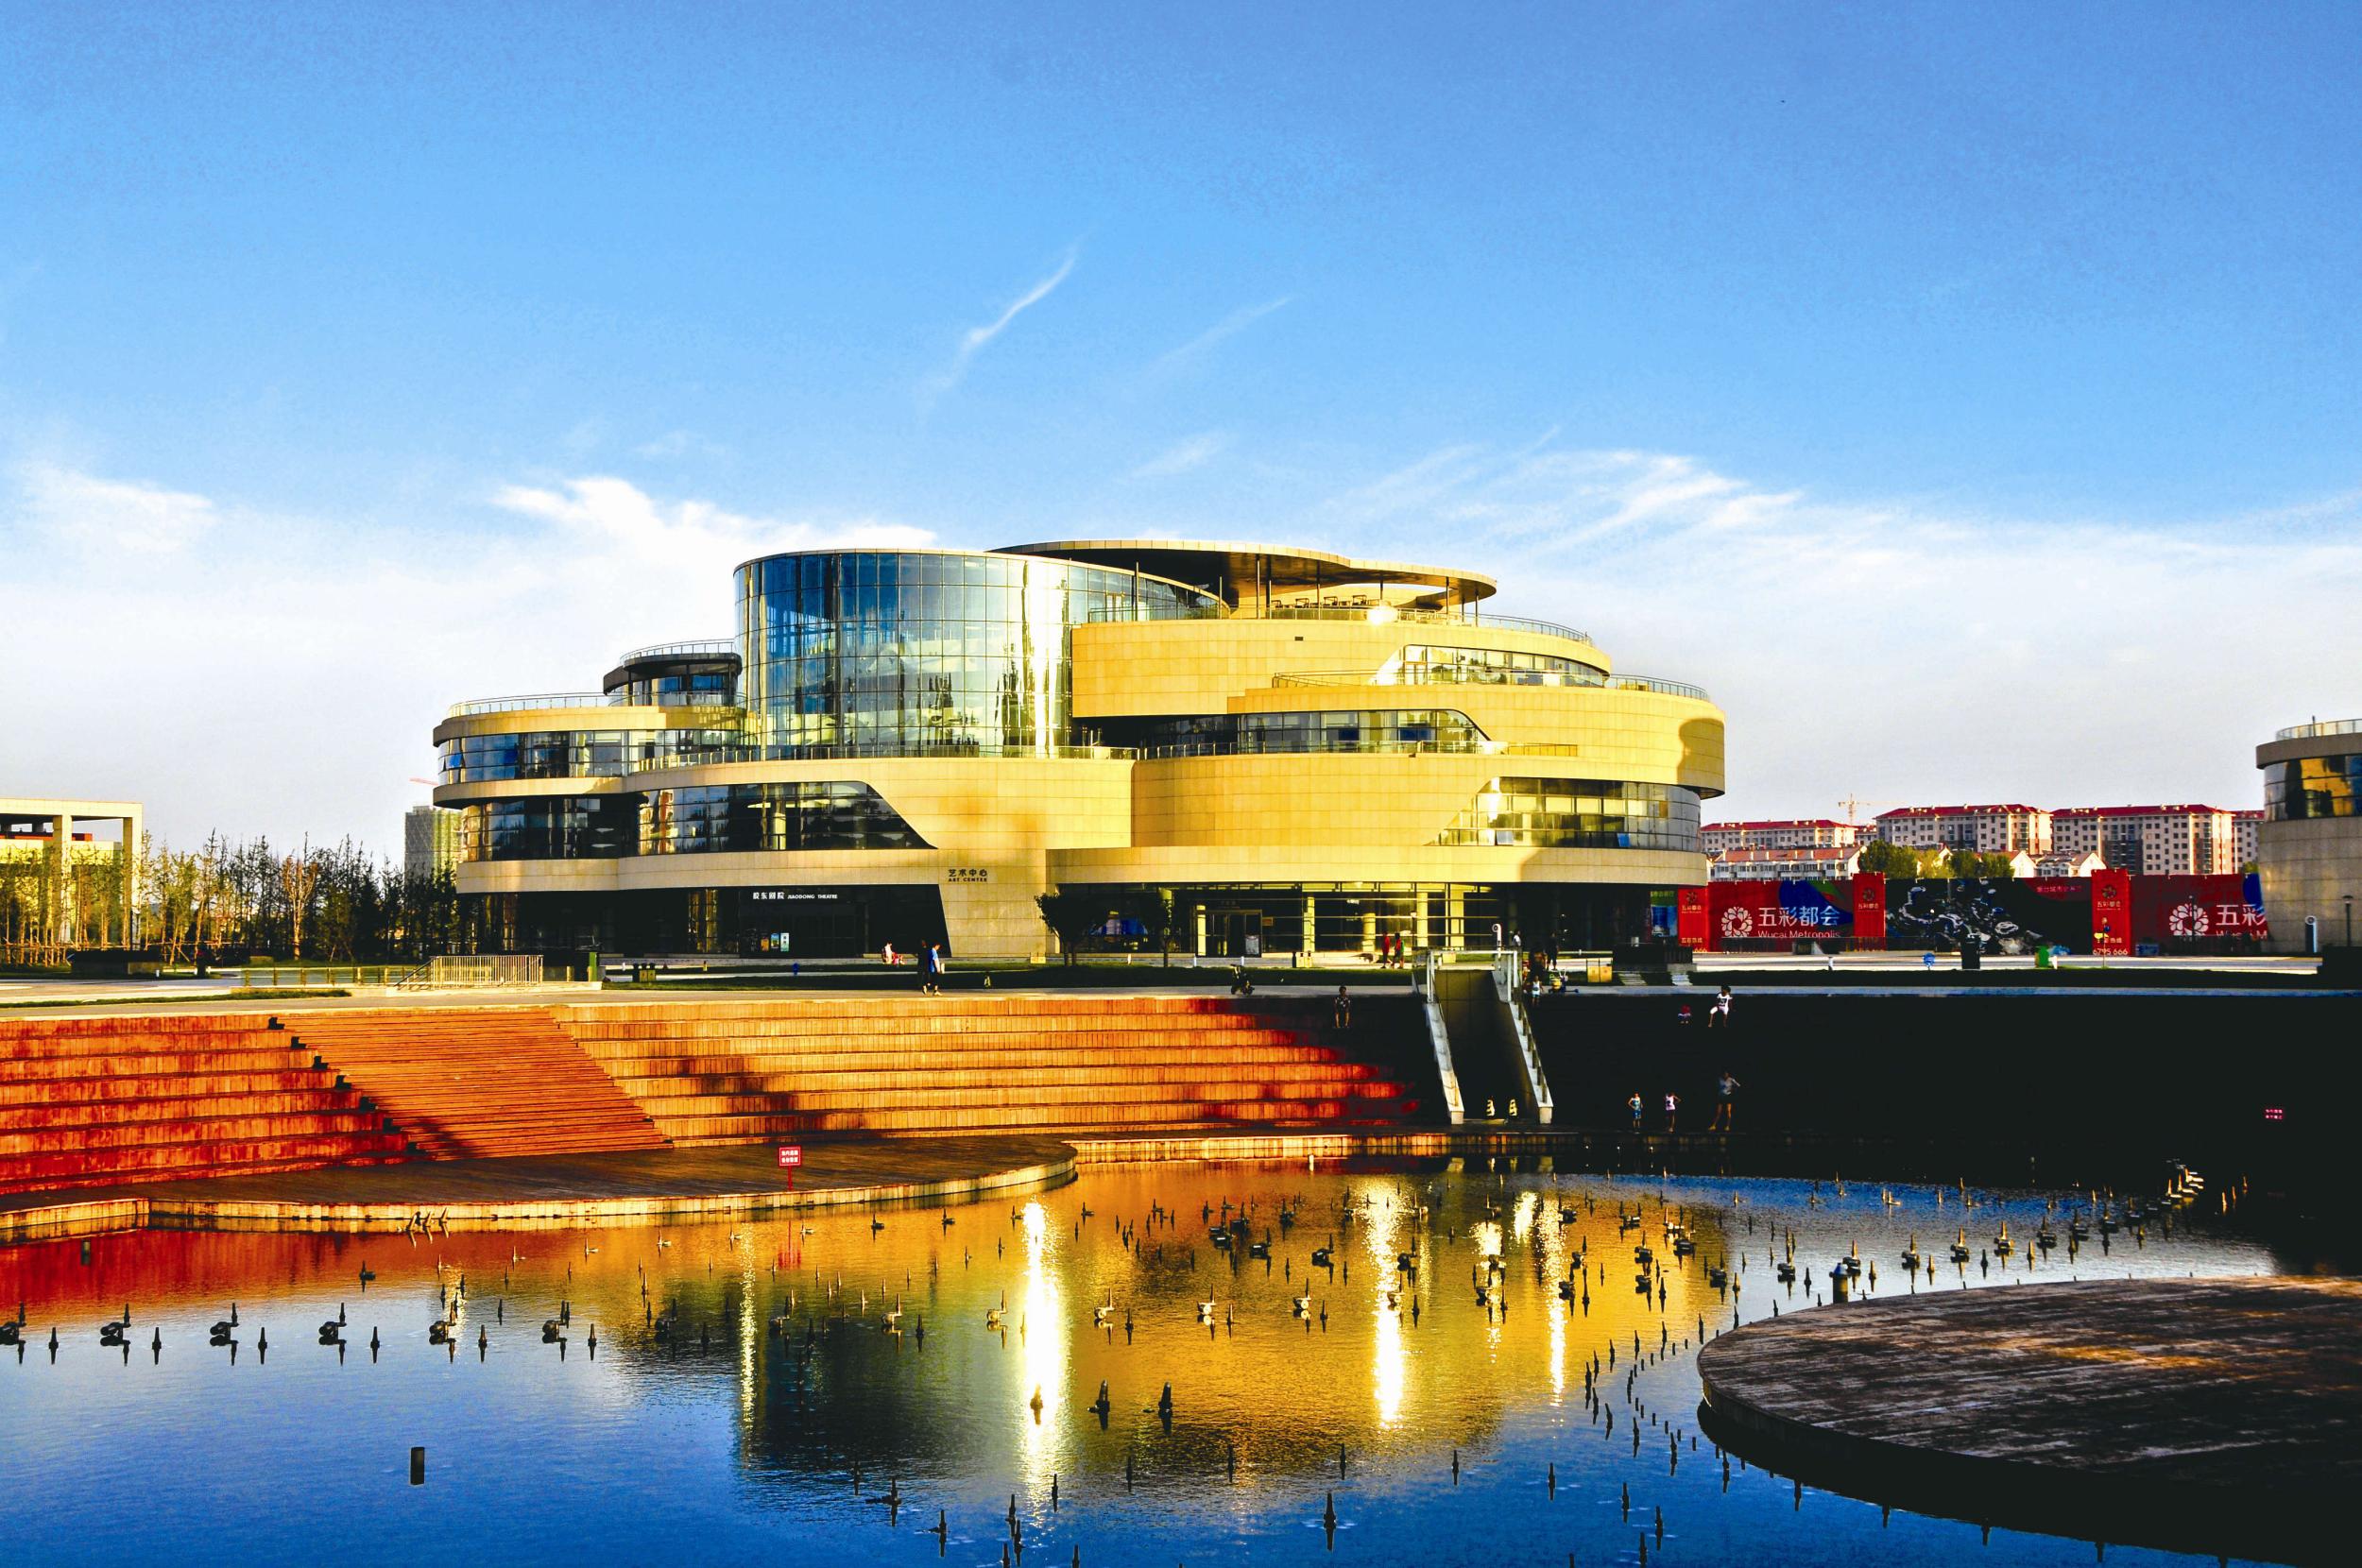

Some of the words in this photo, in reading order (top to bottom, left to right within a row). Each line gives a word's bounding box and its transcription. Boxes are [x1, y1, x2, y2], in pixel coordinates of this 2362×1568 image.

[948, 868, 987, 878] 艺术中心
[752, 892, 785, 900] 胶东剧院
[1757, 905, 1840, 927] 五彩都会
[1789, 929, 1841, 938] Metropolis
[2113, 947, 2129, 956] 666
